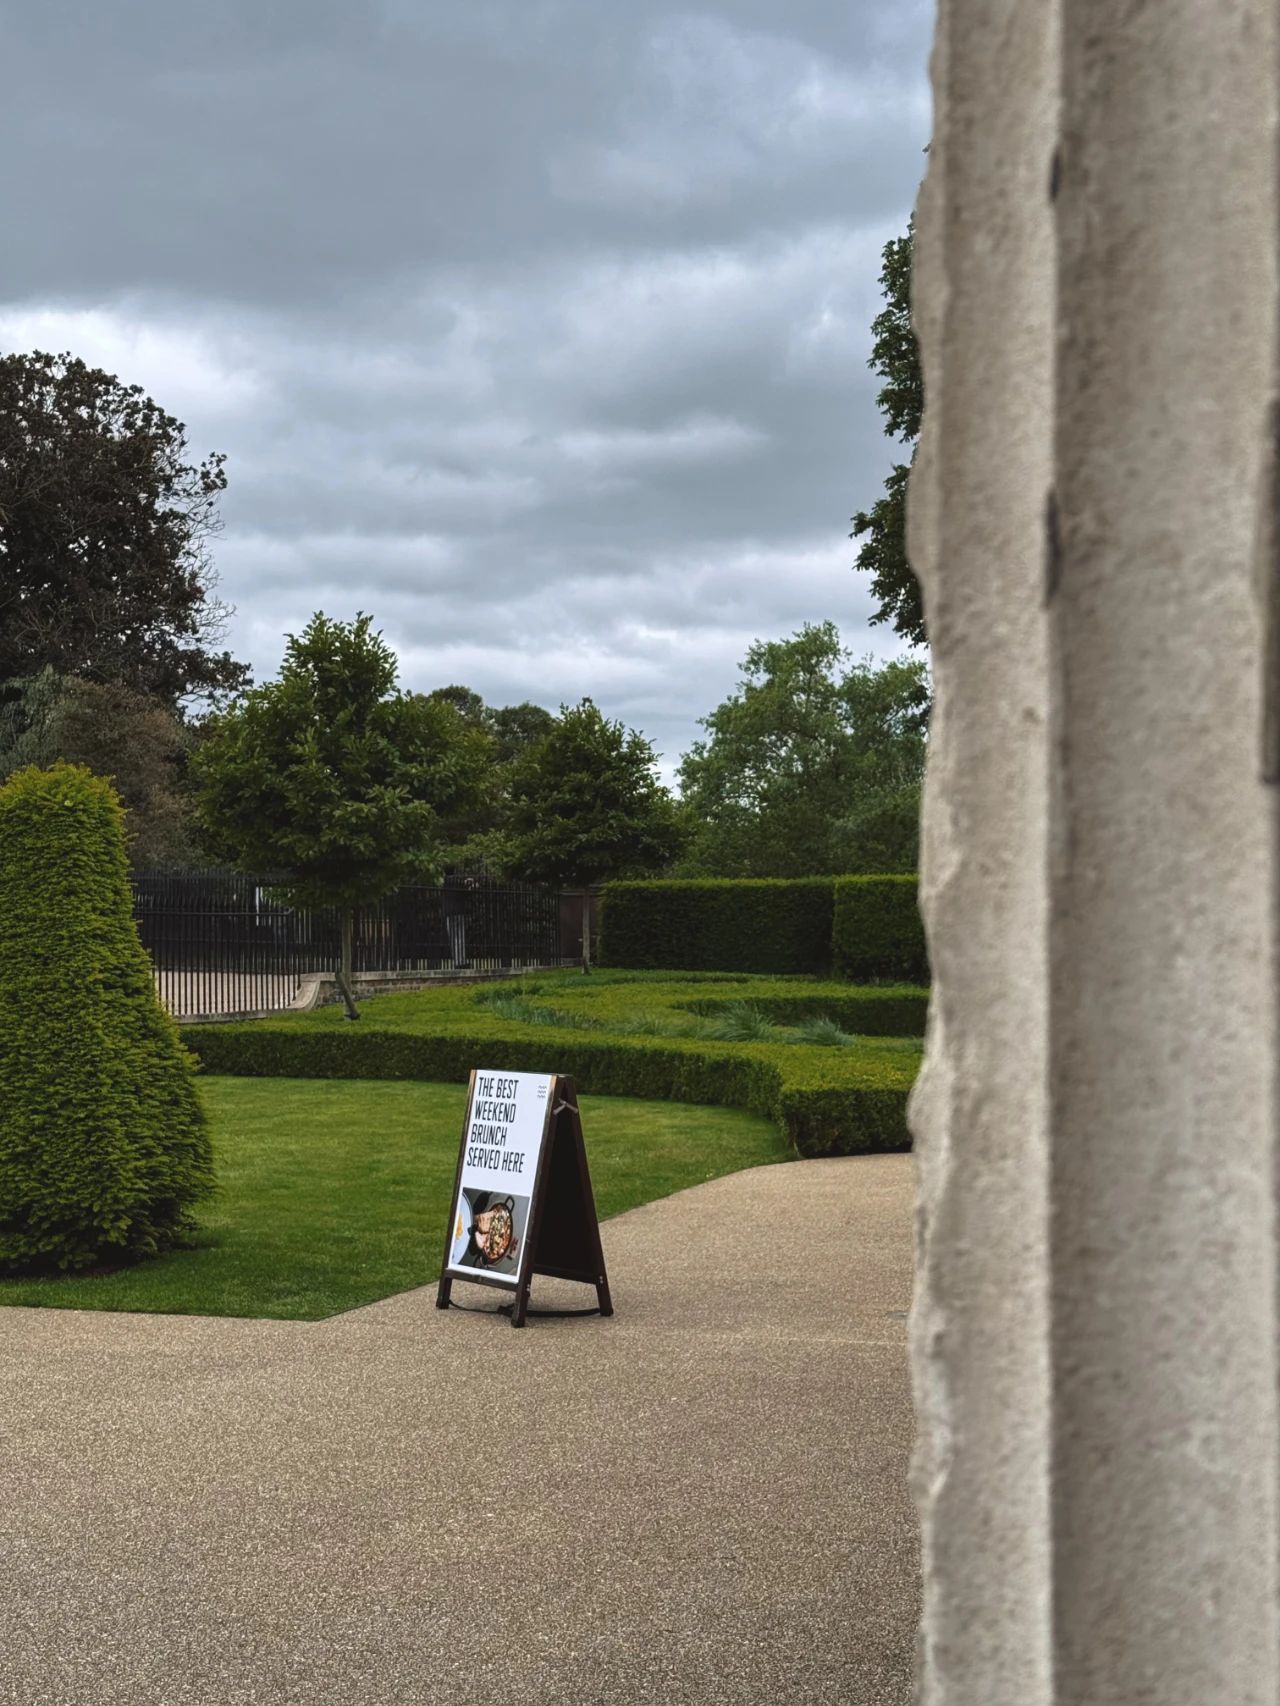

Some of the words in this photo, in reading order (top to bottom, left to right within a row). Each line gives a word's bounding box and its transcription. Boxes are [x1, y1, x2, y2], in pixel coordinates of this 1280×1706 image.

[478, 1076, 495, 1098] THE
[496, 1078, 520, 1099] BEST
[474, 1100, 516, 1123] WEEKEND
[470, 1124, 508, 1146] BRUNCH
[466, 1146, 501, 1170] SERVED
[501, 1150, 526, 1173] HERE
